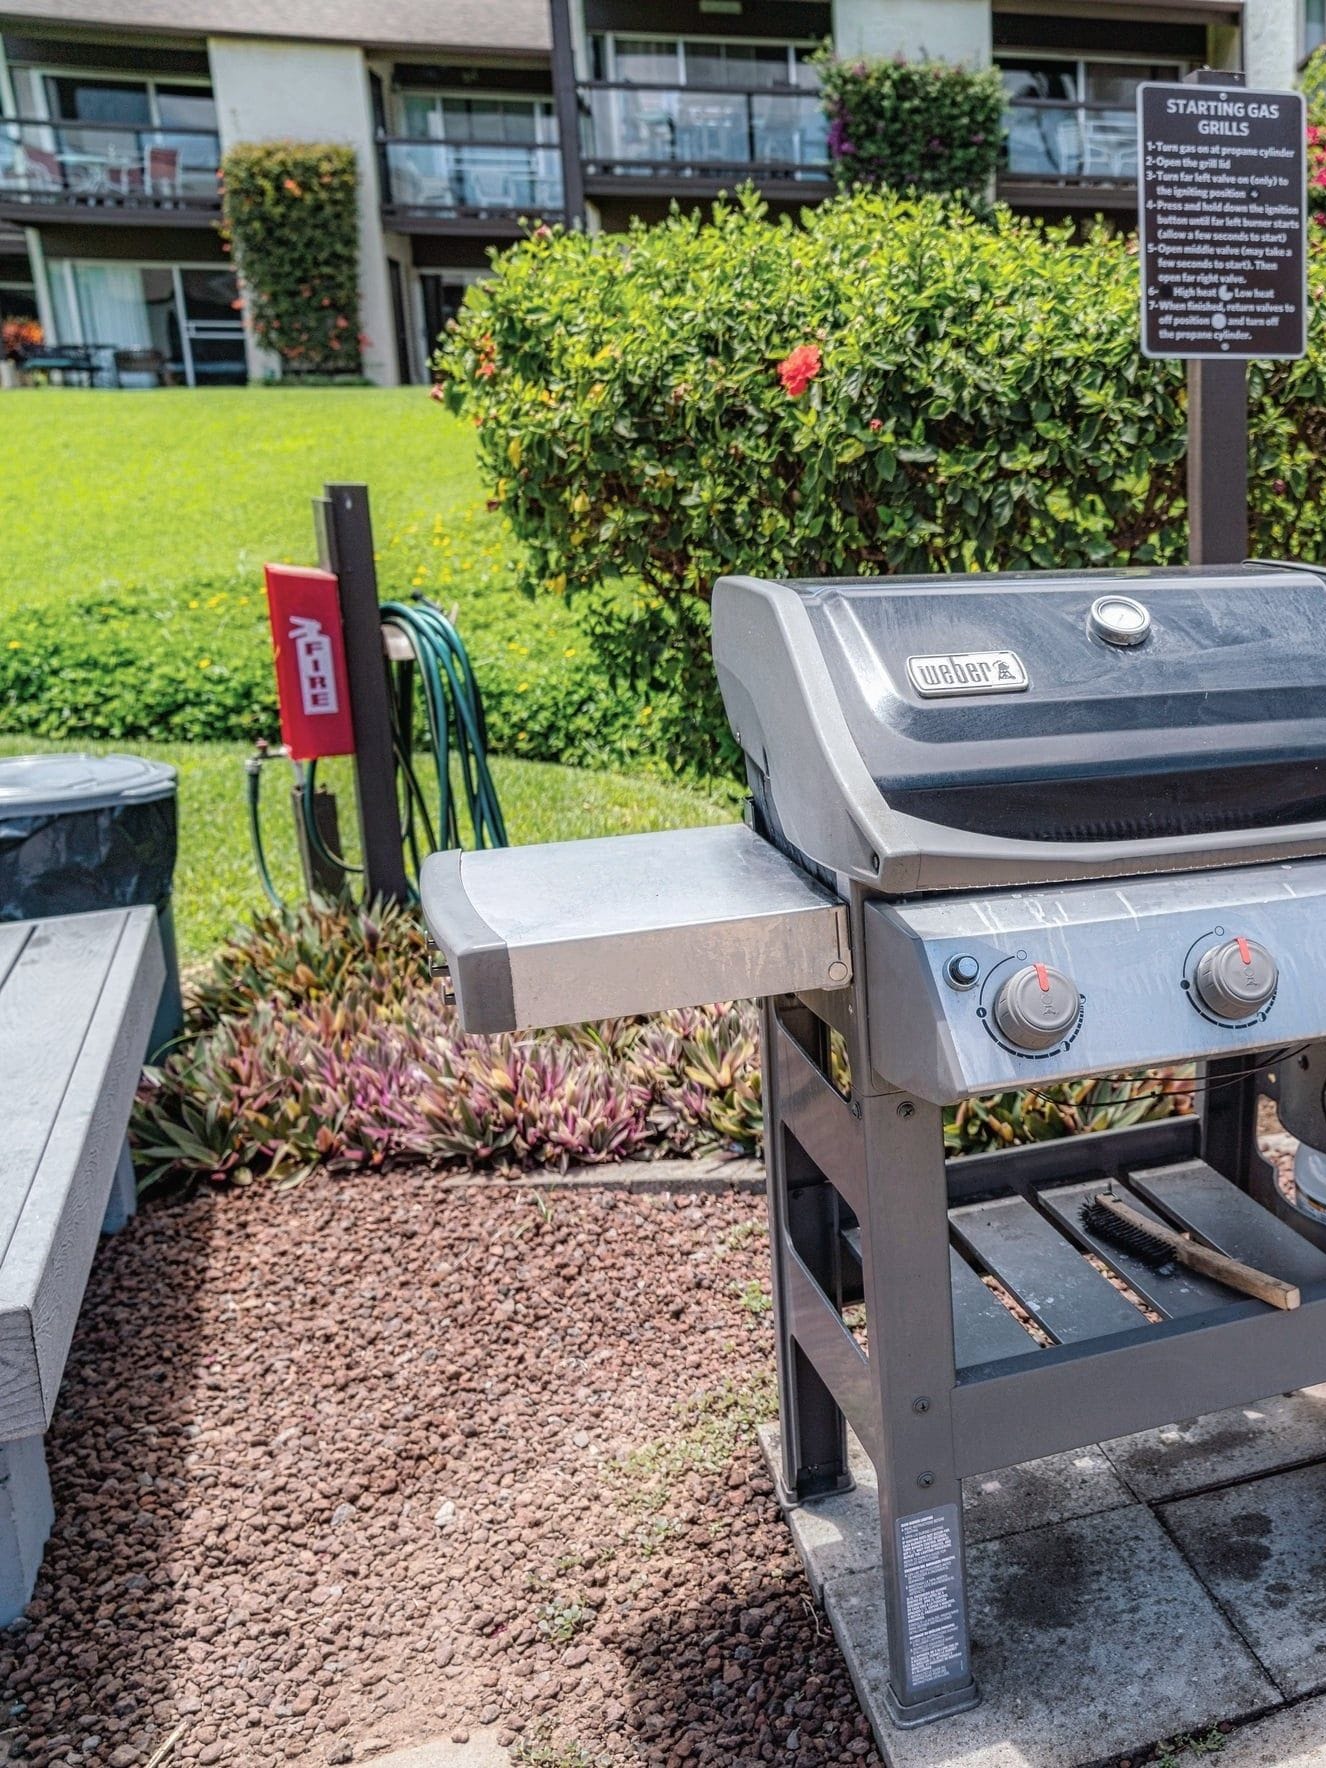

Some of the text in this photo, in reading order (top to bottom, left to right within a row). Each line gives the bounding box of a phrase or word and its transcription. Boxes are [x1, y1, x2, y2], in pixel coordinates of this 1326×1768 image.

[1167, 99, 1279, 118] STARTING GAS
[1198, 120, 1250, 136] GRILLS
[1180, 144, 1195, 154] gas
[1197, 146, 1208, 154] on
[1210, 145, 1219, 154] at
[1221, 146, 1258, 157] propane
[1259, 147, 1294, 158] cylinder
[1183, 158, 1198, 168] the
[1199, 159, 1217, 170] grill
[1219, 159, 1231, 169] lid
[1180, 172, 1193, 182] far
[1195, 173, 1211, 183] left
[1212, 174, 1236, 184] valve
[1279, 177, 1289, 186] to
[1156, 186, 1246, 199] the igniting position
[1184, 200, 1200, 211] and
[1202, 201, 1222, 212] hold
[1224, 202, 1248, 212] down
[1249, 204, 1264, 213] the
[1265, 204, 1298, 216] ignition
[1157, 215, 1299, 229] button until far left burner starts
[1157, 229, 1186, 240] (allow
[1195, 230, 1211, 240] few
[1213, 232, 1248, 241] seconds
[1250, 233, 1259, 241] to
[1184, 244, 1215, 254] middle
[1216, 246, 1240, 255] valve
[1265, 246, 1284, 256] take
[1158, 258, 1175, 268] few
[1176, 259, 1212, 269] seconds
[1214, 260, 1223, 269] to
[1255, 261, 1277, 270] Then
[1158, 274, 1181, 284] open
[1182, 273, 1196, 282] far
[1197, 273, 1219, 285] right
[1173, 286, 1195, 298] High
[1196, 287, 1216, 297] heat
[1235, 288, 1252, 298] Low
[1254, 288, 1274, 298] heat
[1227, 303, 1254, 312] return
[1256, 303, 1283, 312] valves
[1285, 304, 1295, 312] to
[1158, 315, 1279, 326] off position and turn off
[1158, 329, 1174, 339] the
[1176, 332, 1212, 341] propane
[305, 642, 329, 706] FIRE
[917, 656, 991, 685] weber
